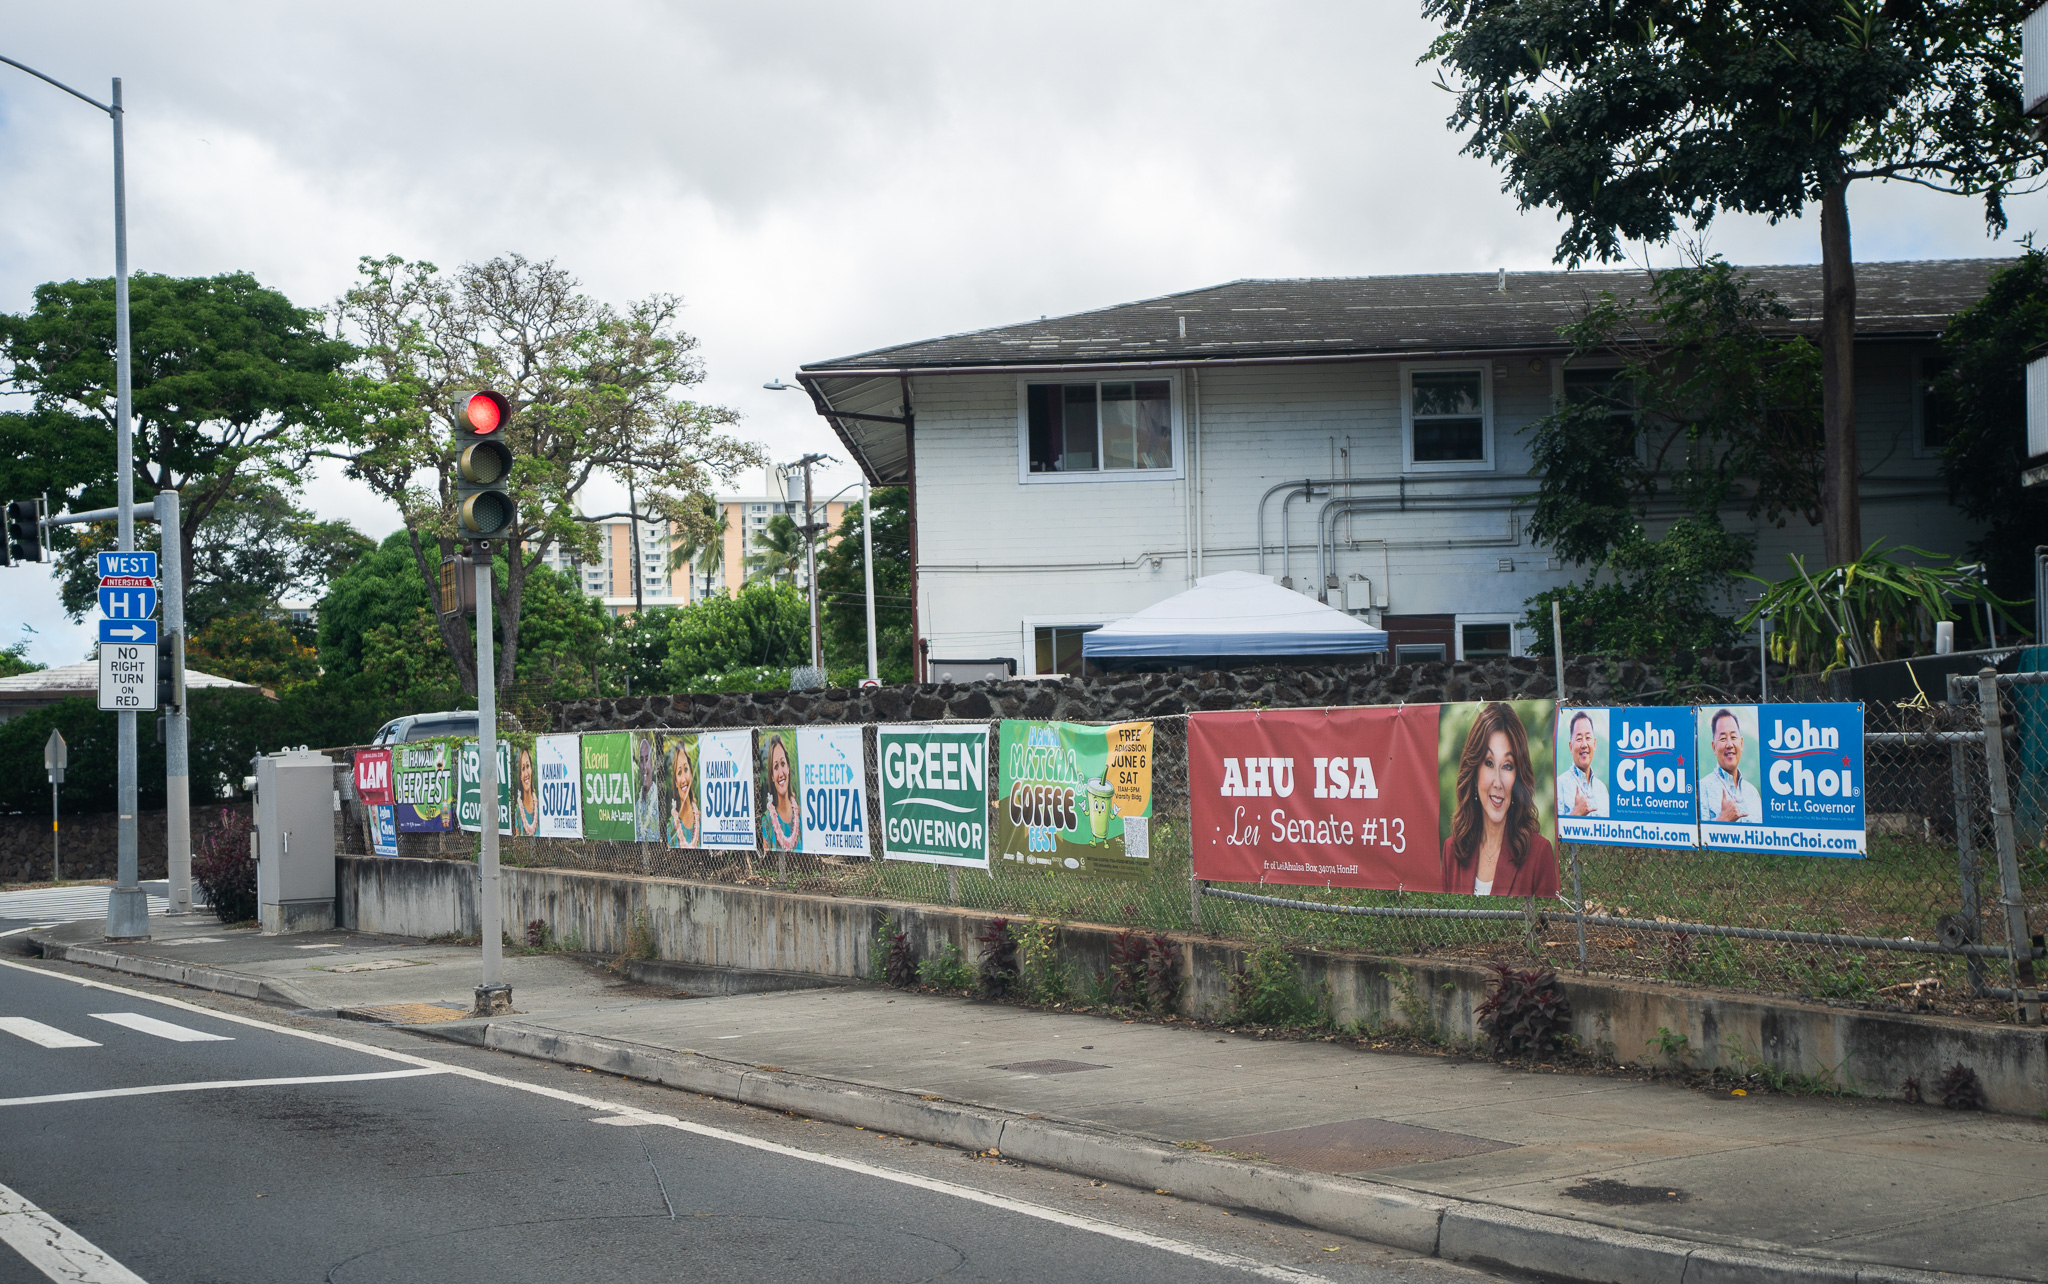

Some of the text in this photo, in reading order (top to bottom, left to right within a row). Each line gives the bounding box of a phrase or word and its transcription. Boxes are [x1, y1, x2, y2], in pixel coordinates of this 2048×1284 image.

[106, 557, 149, 573] WEST
[107, 578, 147, 586] INTERSTATE
[118, 647, 138, 660] NO
[111, 661, 145, 672] RIGHT
[112, 673, 144, 684] TURN
[121, 686, 134, 694] ON
[116, 696, 140, 706] RED
[1119, 729, 1142, 742] FREE
[1616, 721, 1675, 751] John
[1768, 719, 1839, 750] John
[584, 746, 609, 770] Keoni
[1115, 744, 1147, 753] ADMISSION
[462, 751, 506, 784] GRN
[542, 763, 563, 780] KANANI
[706, 760, 731, 779] KANANI
[885, 742, 982, 791] GREEN
[1010, 743, 1078, 784] MATCHA
[1112, 755, 1146, 769] JUNE 6
[359, 761, 388, 789] LAM
[805, 764, 845, 785] RE-ELECT
[1119, 772, 1138, 785] SAT
[1220, 756, 1379, 800] AHU ISA
[1616, 757, 1686, 794] Choi
[1769, 758, 1852, 797] Choi
[397, 769, 451, 805] BEERFEST
[585, 773, 632, 805] SOUZA
[542, 782, 577, 816] SOUZA
[706, 781, 750, 818] SOUZA
[1010, 781, 1078, 832] COFFEE
[1115, 793, 1142, 803] Varsity Bldg
[1617, 794, 1688, 809] for Lt. Governor
[1771, 798, 1856, 814] for Lt. Governor
[379, 806, 391, 819] John
[598, 809, 633, 825] OHA At-Large
[807, 788, 863, 832] SOUZA
[554, 818, 578, 831] STATE HOUSE
[720, 820, 750, 832] STATE HOUSE
[889, 817, 982, 850] GOVERNOR
[1226, 805, 1261, 846] Lei
[1270, 808, 1354, 846] Senate
[1360, 817, 1406, 854] #13
[1563, 823, 1690, 844] www.HiJohnChoi.com
[825, 834, 863, 849] STATE HOUSE
[1029, 826, 1057, 852] FEST
[1708, 829, 1857, 851] www.HiJohnChoi.com
[1305, 862, 1318, 873] Box
[1336, 864, 1358, 875] HonHI
